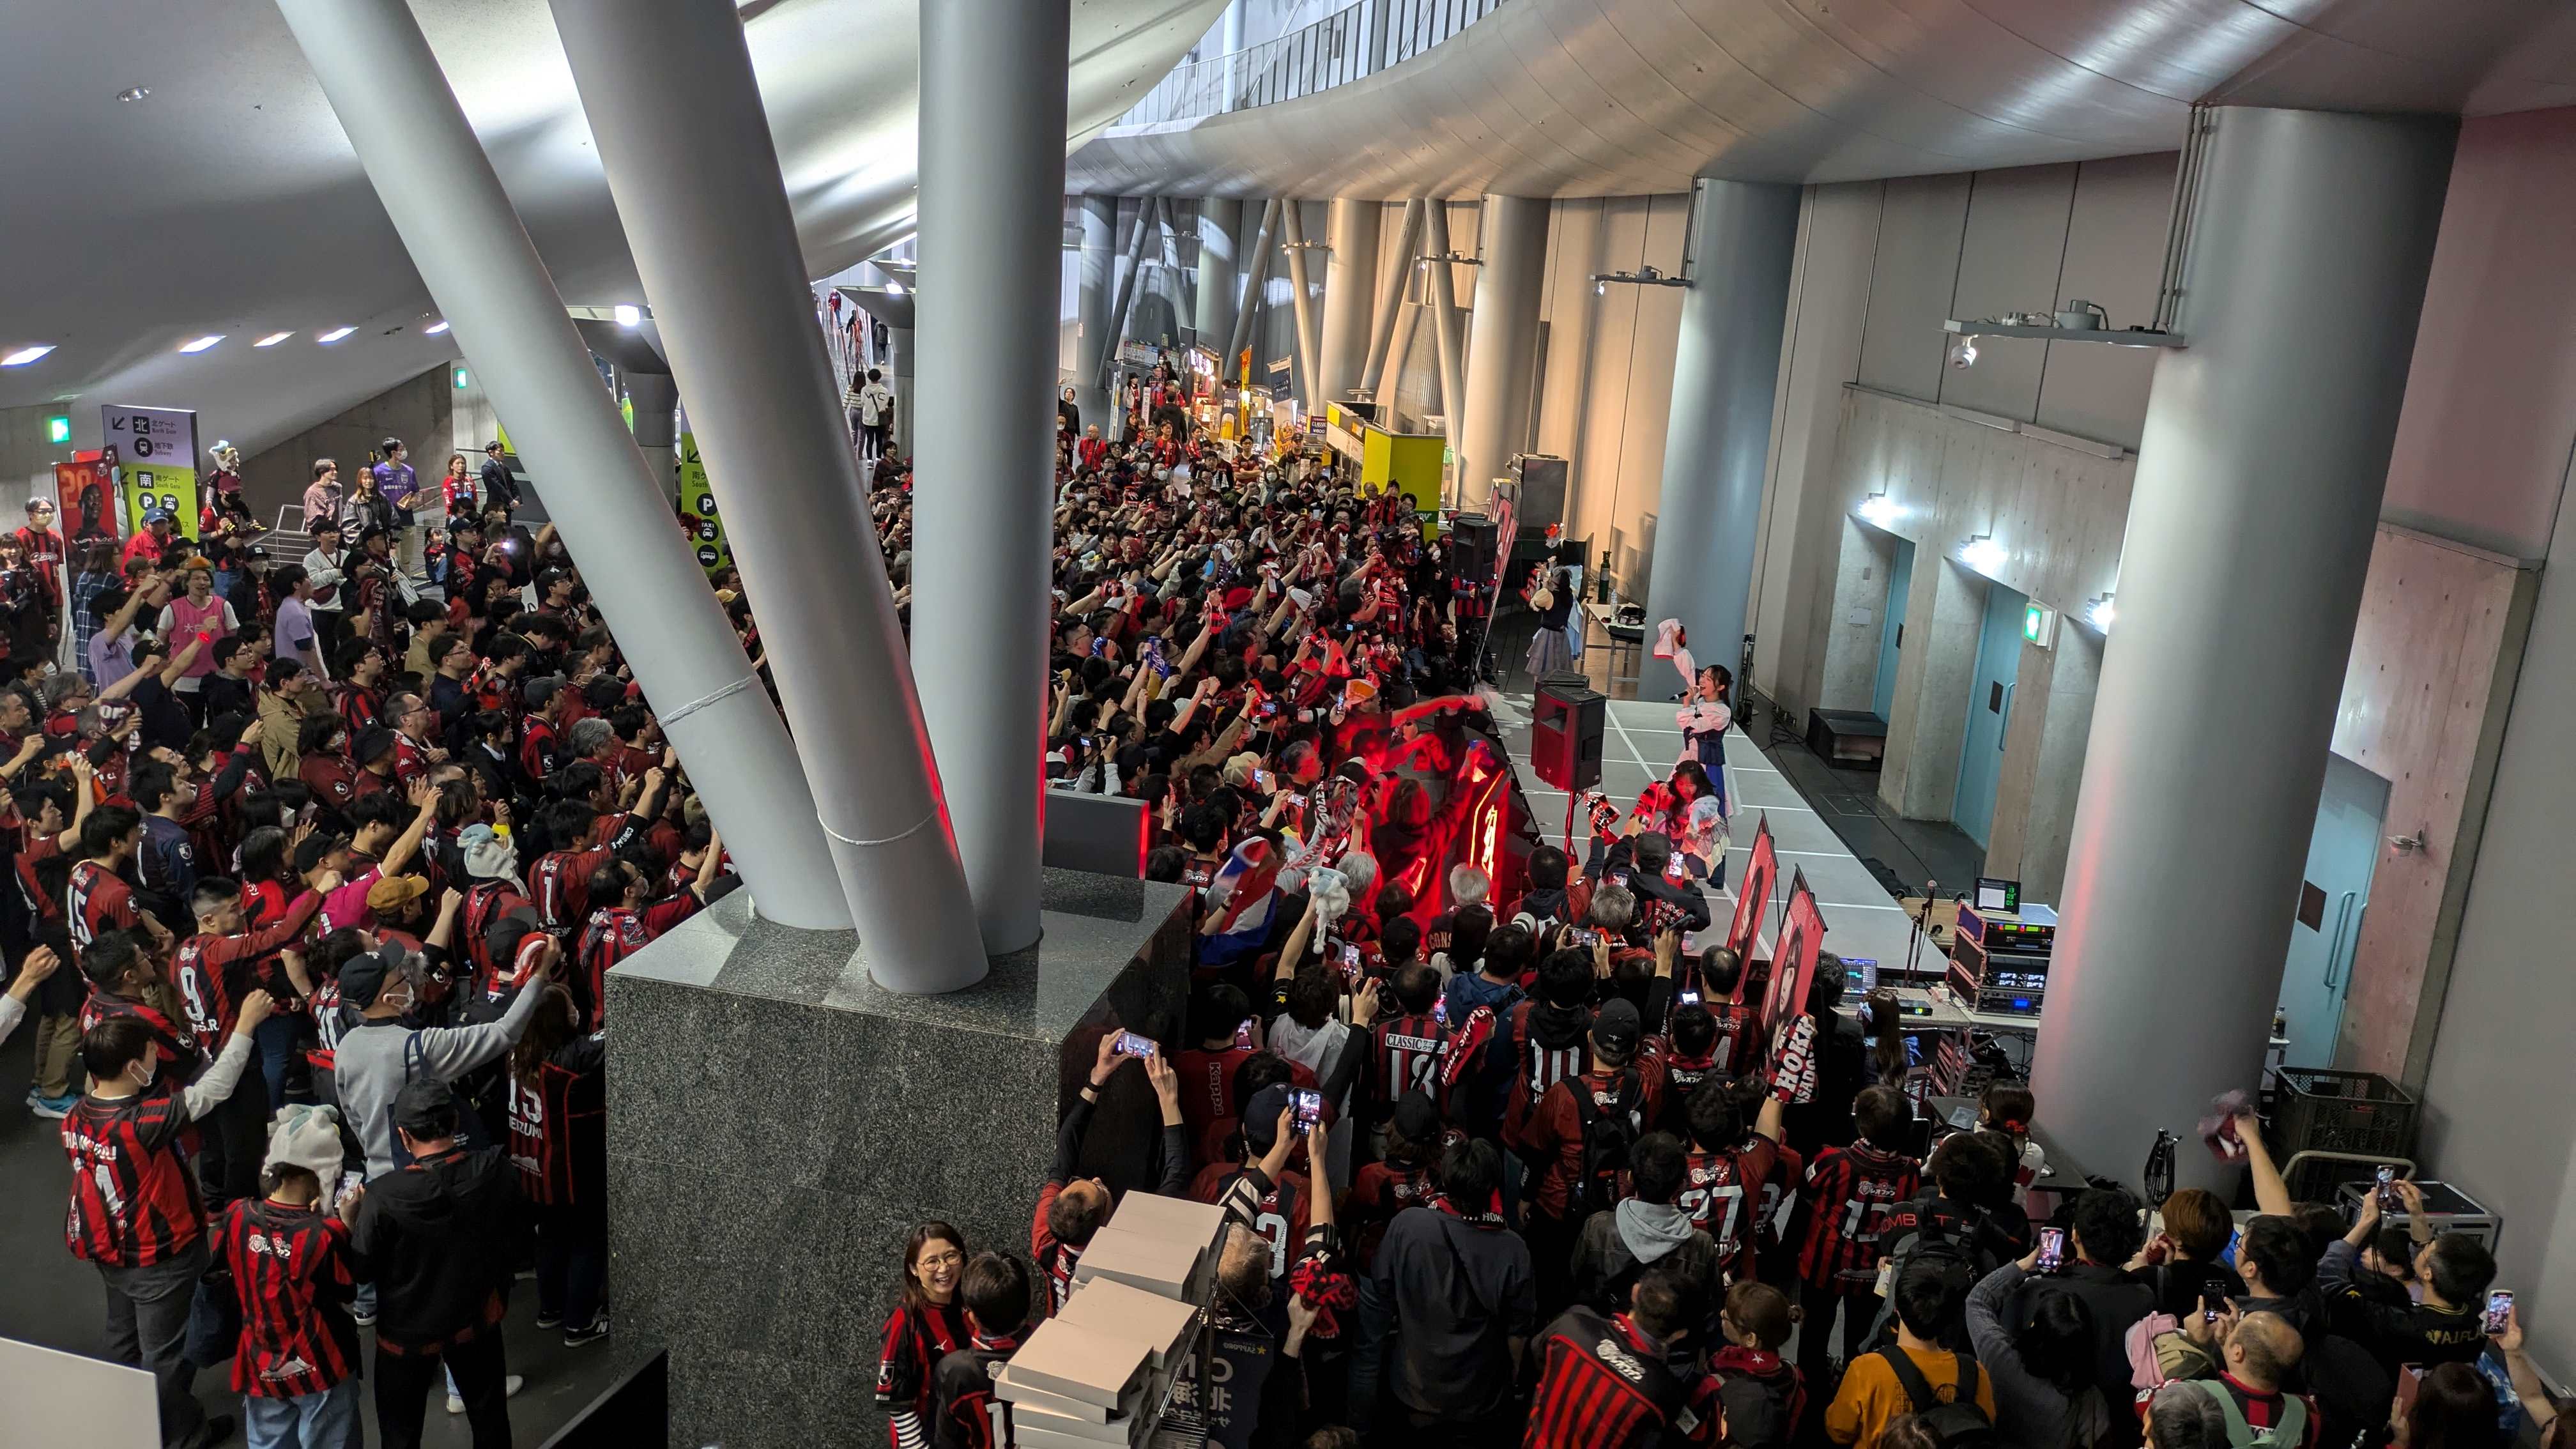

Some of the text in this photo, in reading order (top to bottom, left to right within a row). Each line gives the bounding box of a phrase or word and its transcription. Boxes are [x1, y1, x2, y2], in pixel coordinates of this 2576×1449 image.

[134, 418, 148, 433] 北
[139, 473, 152, 487] 南
[144, 496, 153, 508] P
[703, 498, 713, 511] P
[544, 876, 558, 925] 1
[180, 966, 206, 1022] 9
[1386, 1034, 1422, 1050] CLASSIC
[1531, 1038, 1580, 1093] 10
[1209, 1062, 1224, 1116] Kappa
[1391, 1049, 1435, 1102] 18
[1680, 1184, 1743, 1242] 27
